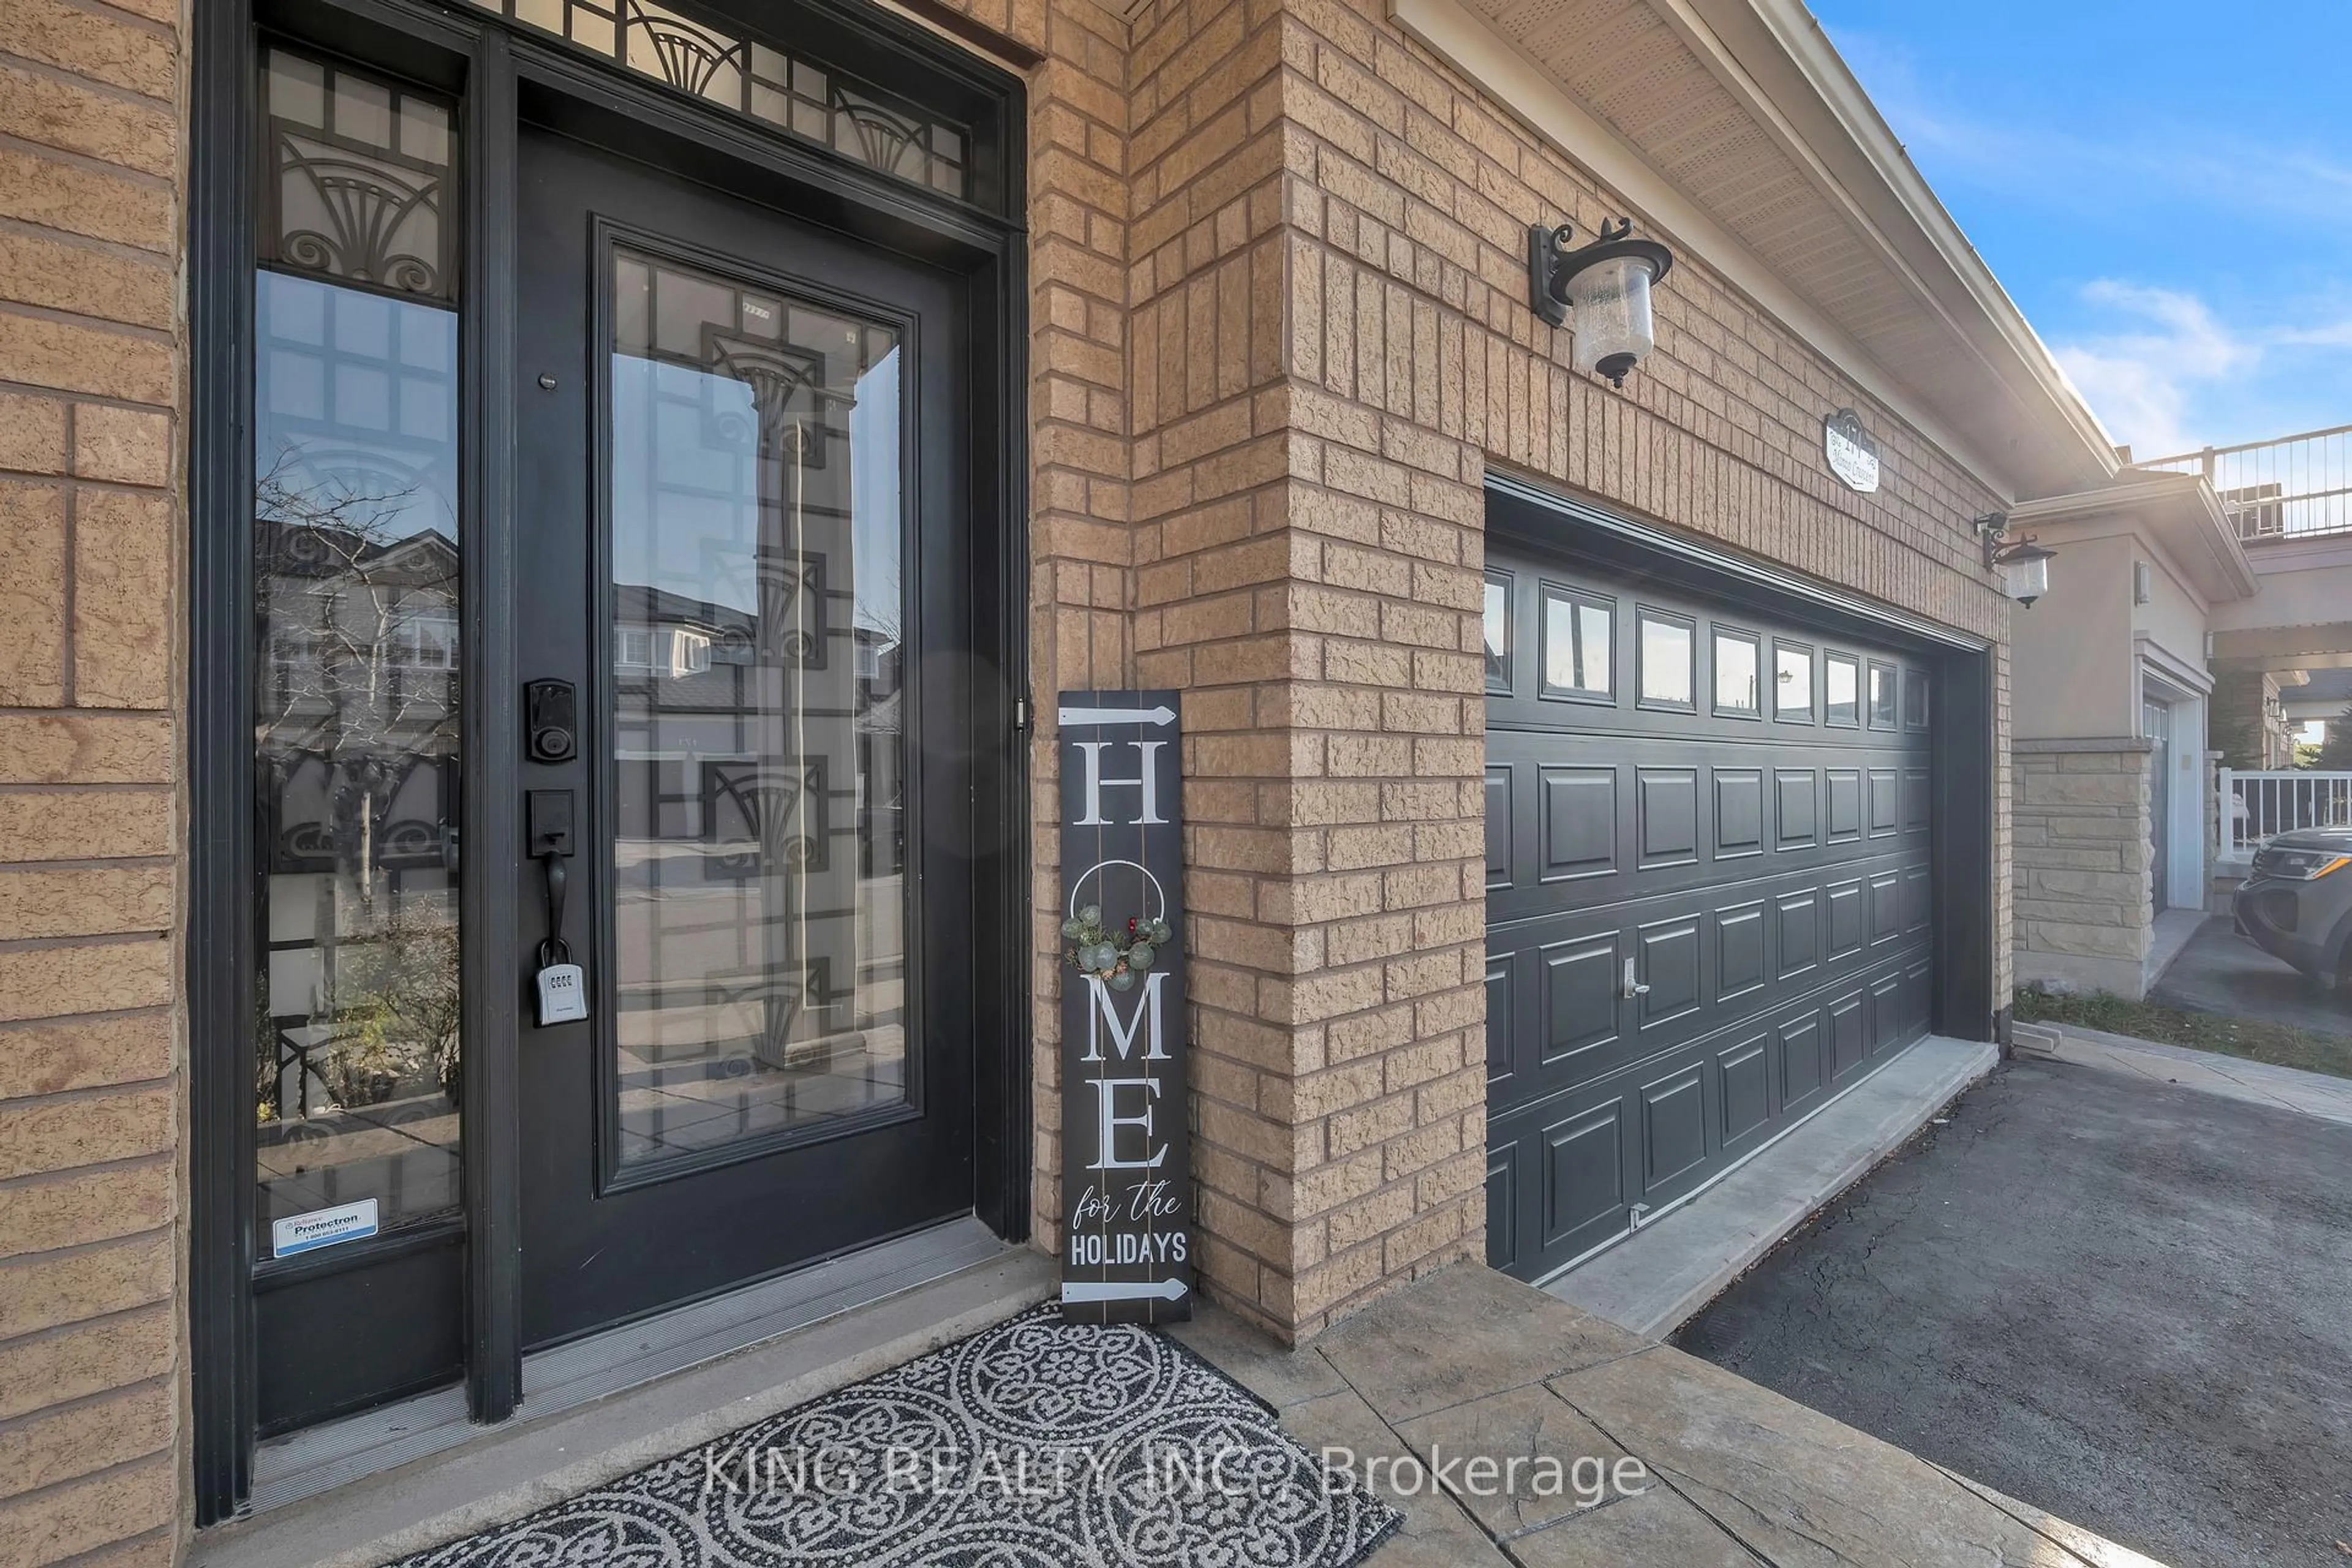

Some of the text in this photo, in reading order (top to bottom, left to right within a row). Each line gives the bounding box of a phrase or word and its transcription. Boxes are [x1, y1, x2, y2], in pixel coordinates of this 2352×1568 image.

[1070, 741, 1172, 1169] HOME
[295, 1215, 358, 1234] Protectron
[1073, 1180, 1182, 1229] for the
[1072, 1232, 1186, 1265] HOLIDAYS
